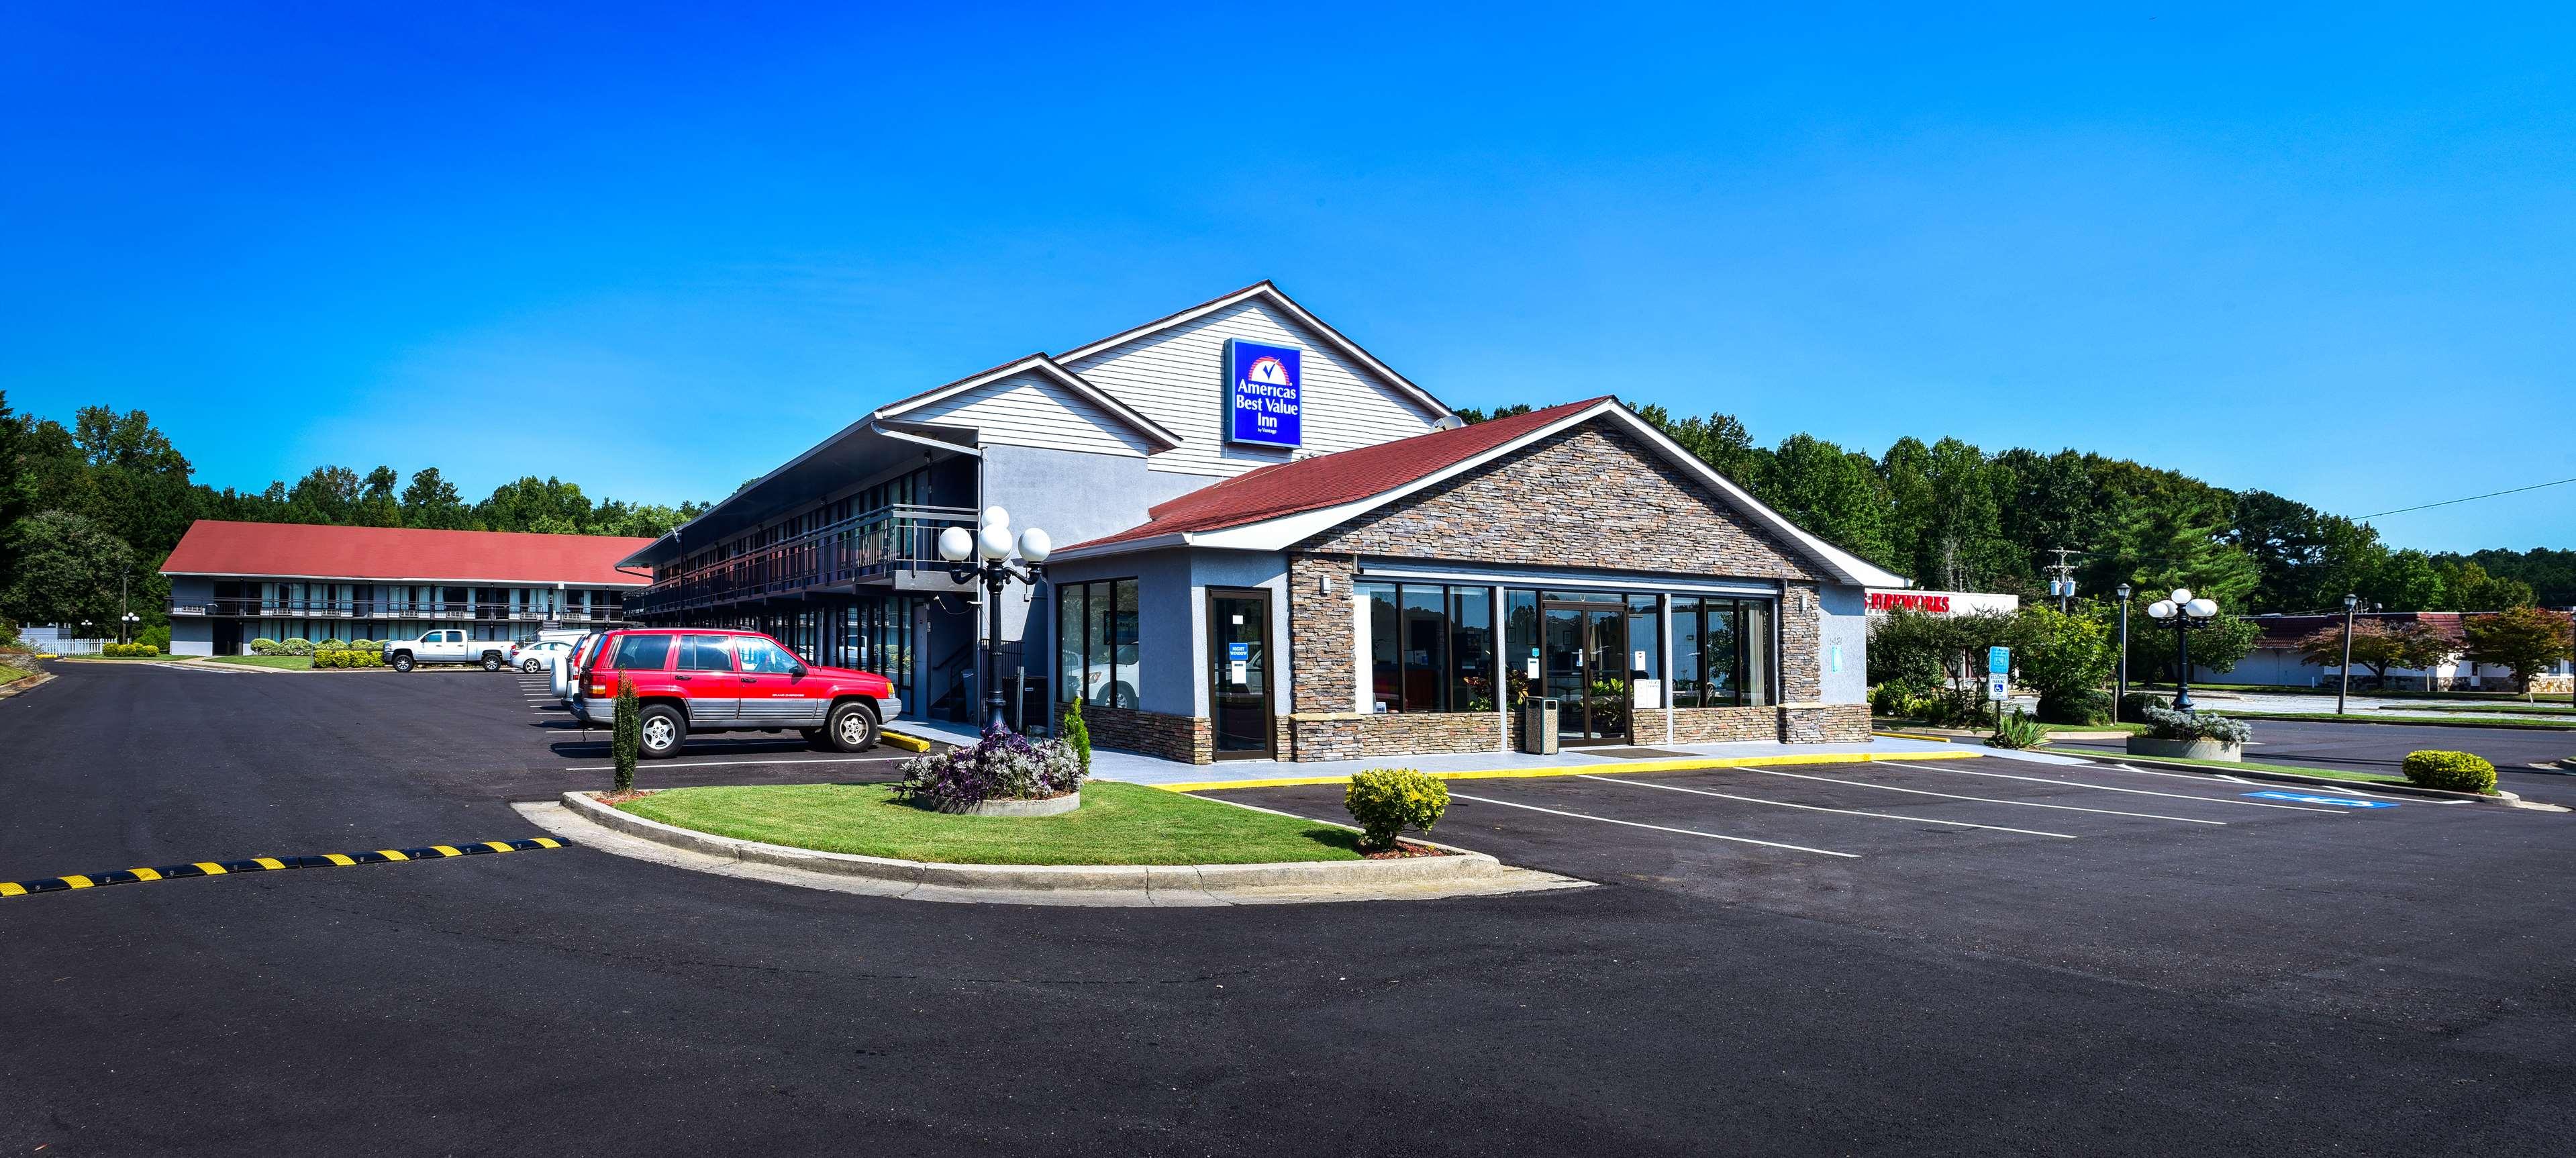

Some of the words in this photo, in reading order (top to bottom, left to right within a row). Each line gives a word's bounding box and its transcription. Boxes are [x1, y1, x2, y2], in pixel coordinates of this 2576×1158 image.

[1238, 379, 1296, 399] Americas
[1236, 394, 1262, 411] Best
[1265, 397, 1298, 416] Value
[1258, 412, 1277, 428] Inn
[1871, 593, 1950, 612] FIREWORKS
